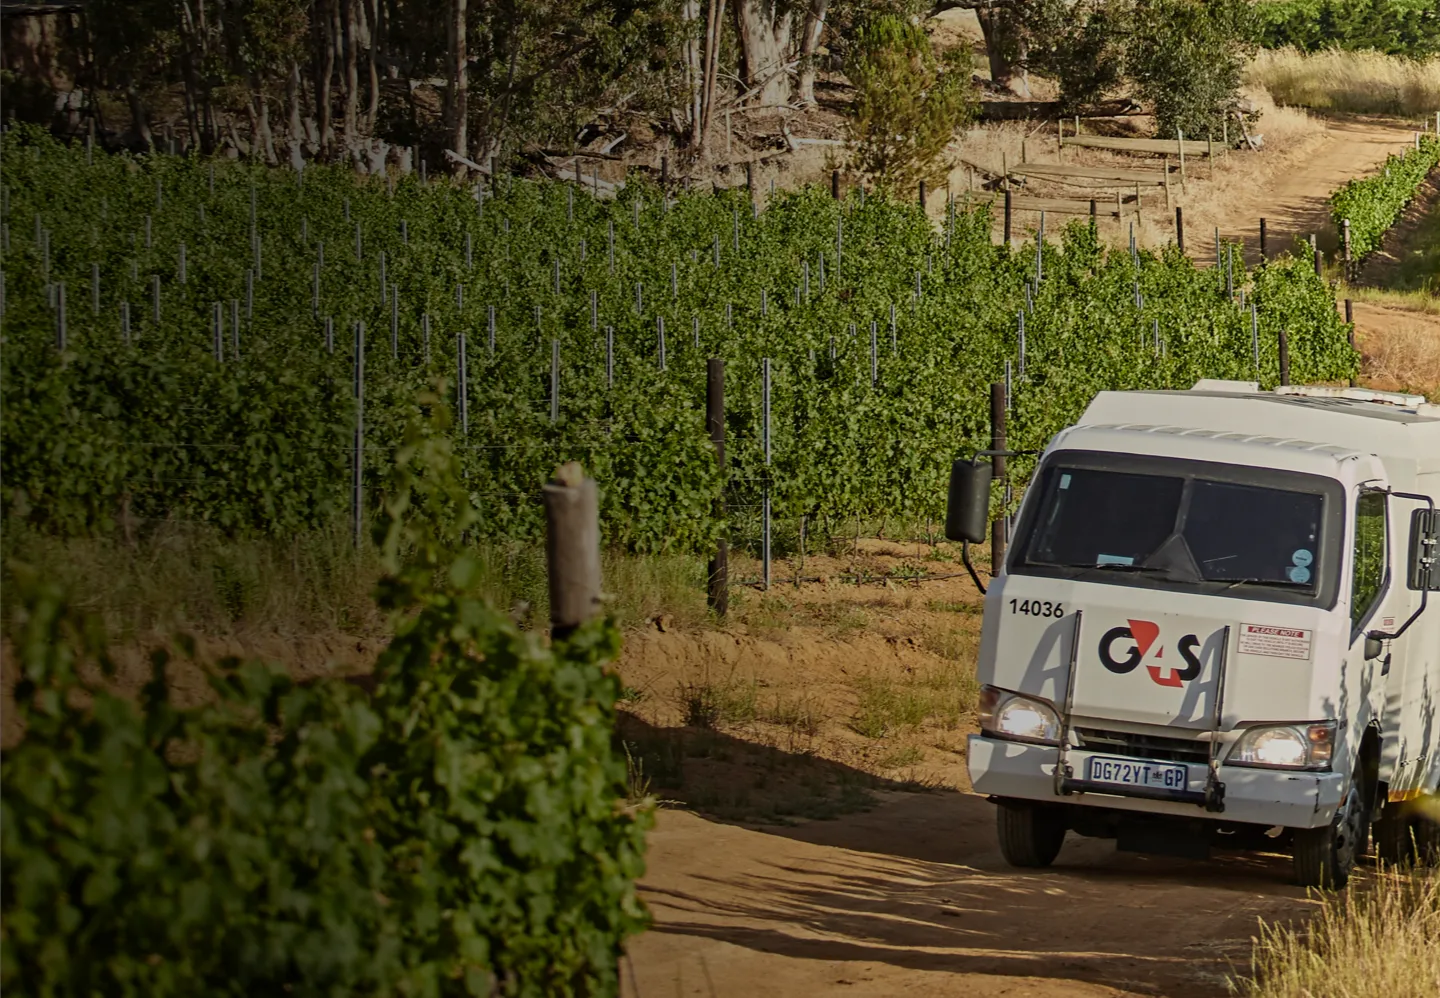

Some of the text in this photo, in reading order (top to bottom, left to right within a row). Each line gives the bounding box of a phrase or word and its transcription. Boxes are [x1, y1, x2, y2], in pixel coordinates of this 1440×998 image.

[1009, 598, 1064, 619] 14036
[1251, 626, 1300, 638] PLEASE NOTE
[1098, 619, 1201, 688] G4S
[1093, 761, 1184, 787] DG72YT GP
